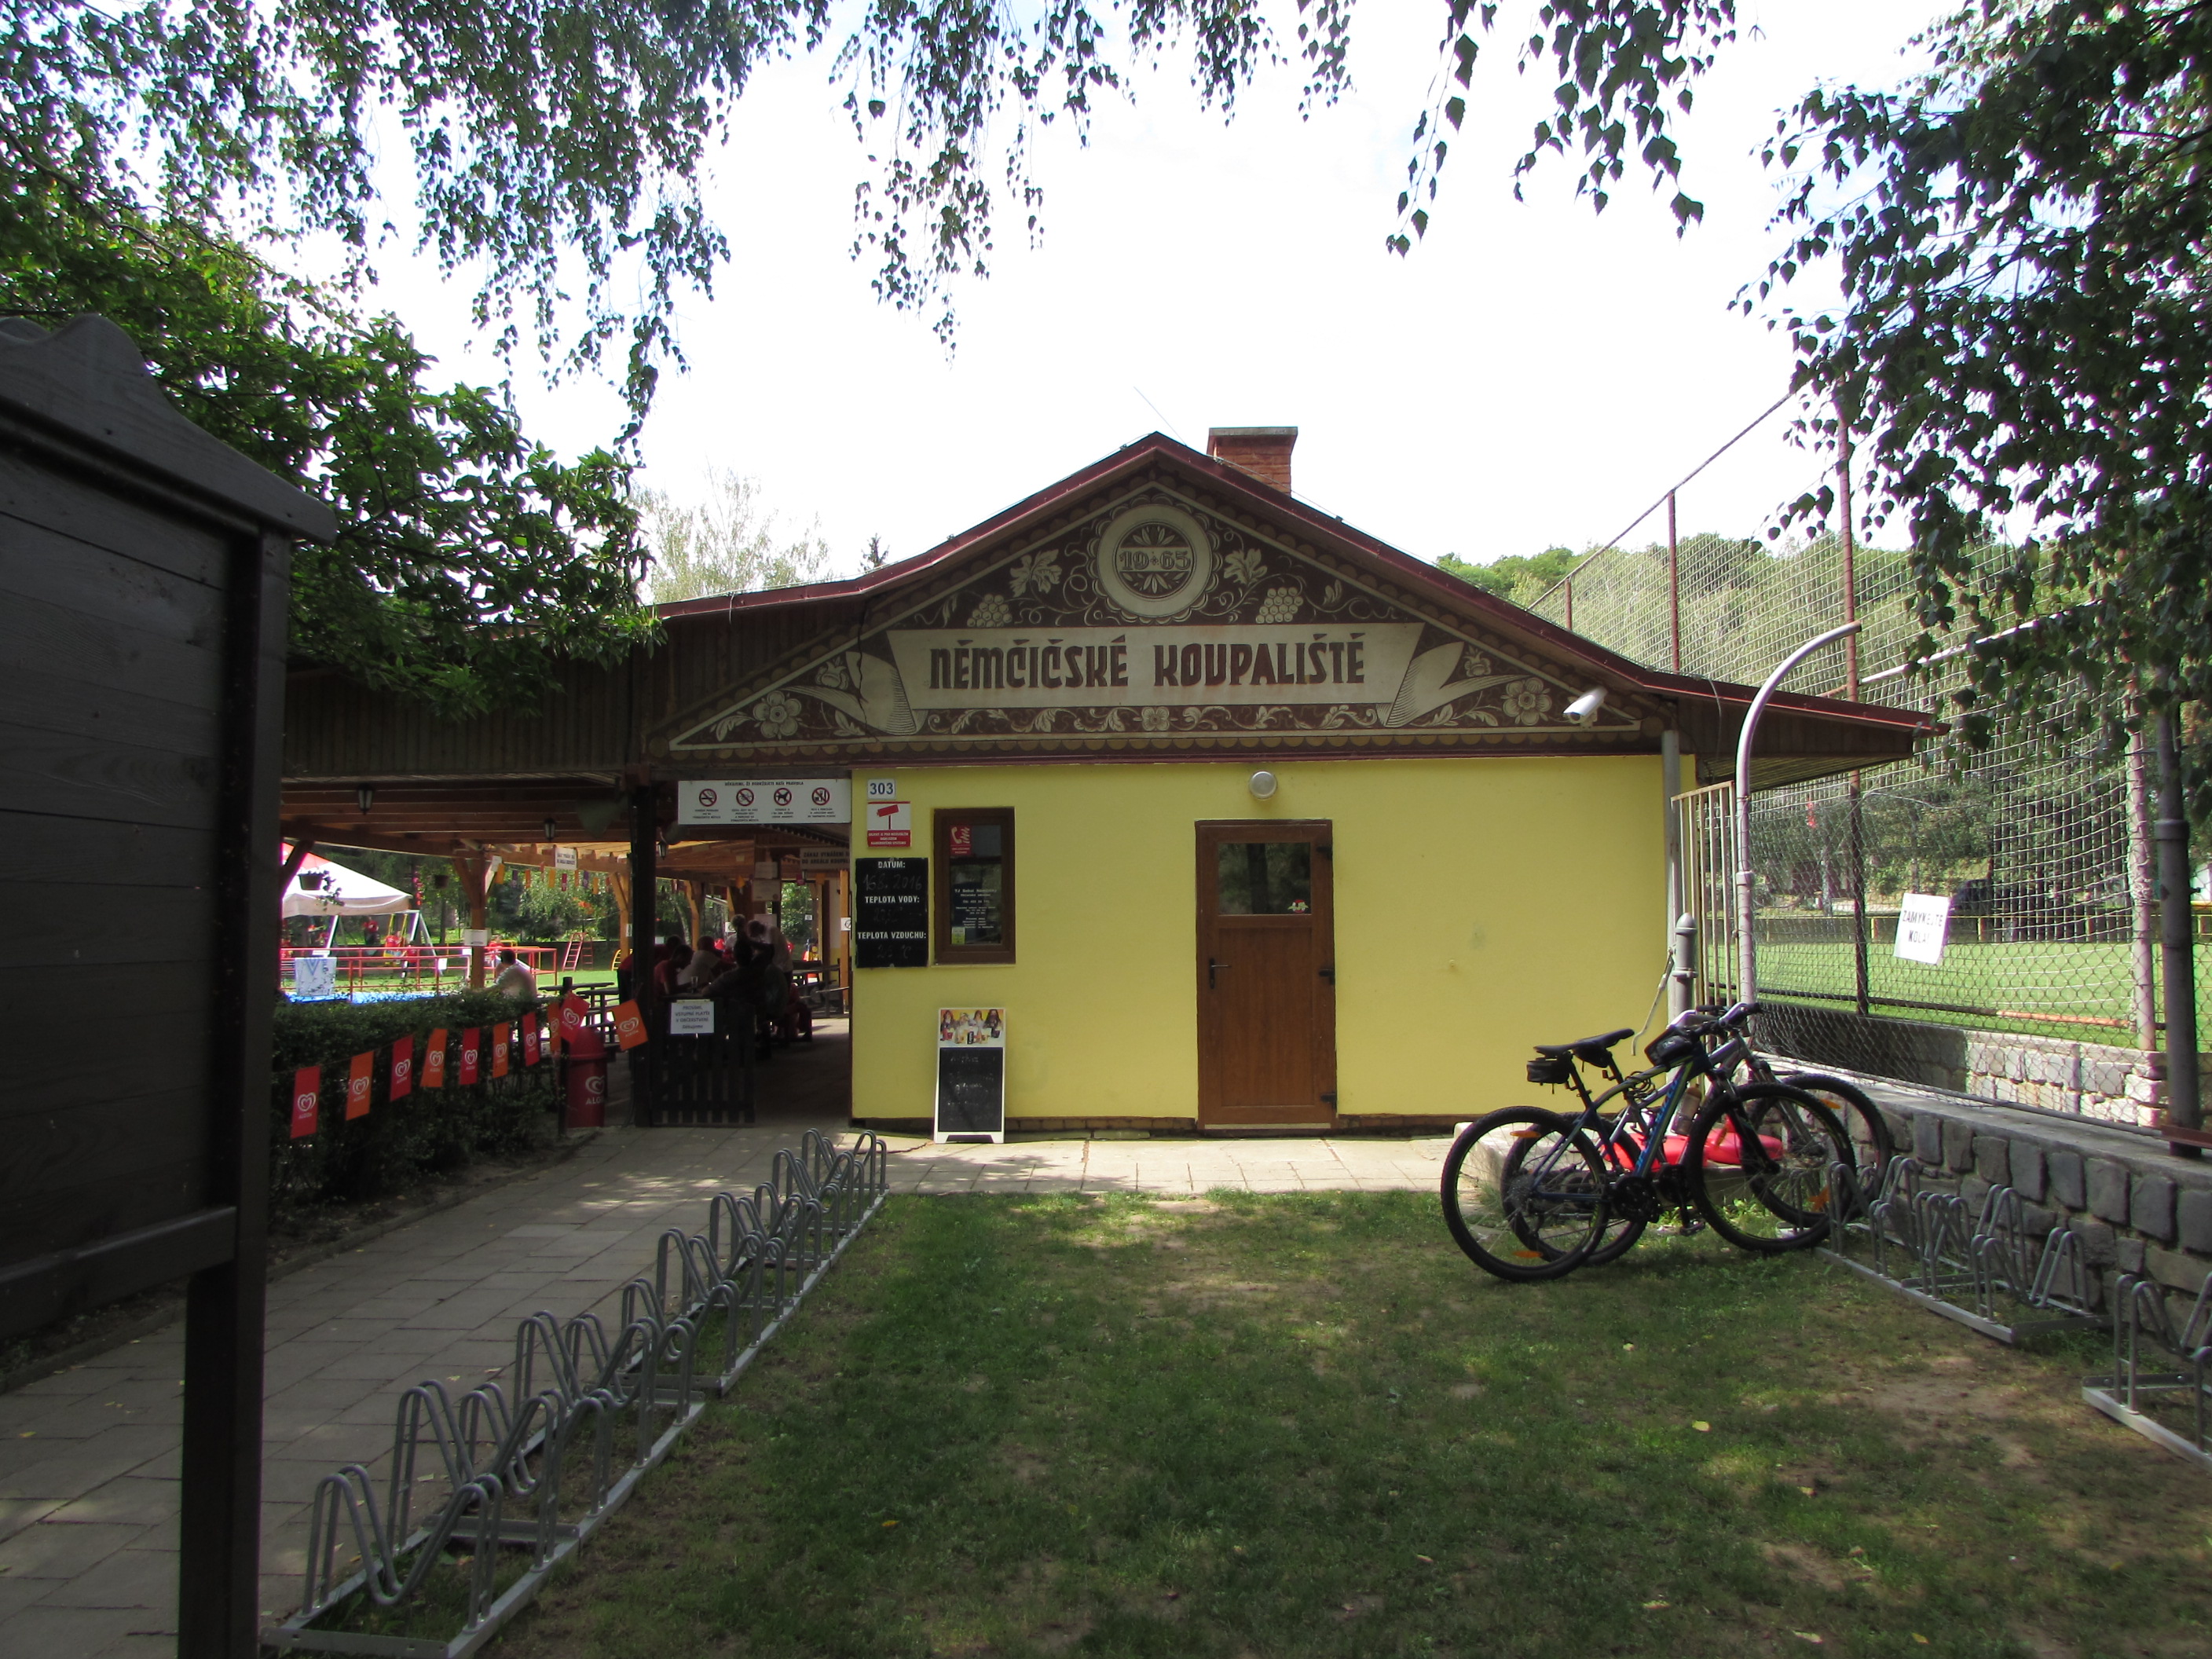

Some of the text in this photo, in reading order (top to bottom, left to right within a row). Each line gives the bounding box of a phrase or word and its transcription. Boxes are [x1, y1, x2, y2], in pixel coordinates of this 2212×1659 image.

[930, 633, 1365, 690] NĚMČIČSKÉ KOUPALIŠTĚ
[870, 782, 893, 795] 303
[893, 873, 922, 891] 2016
[1903, 910, 1944, 927] ZAMYKEJTE
[1908, 929, 1930, 944] KOLA!
